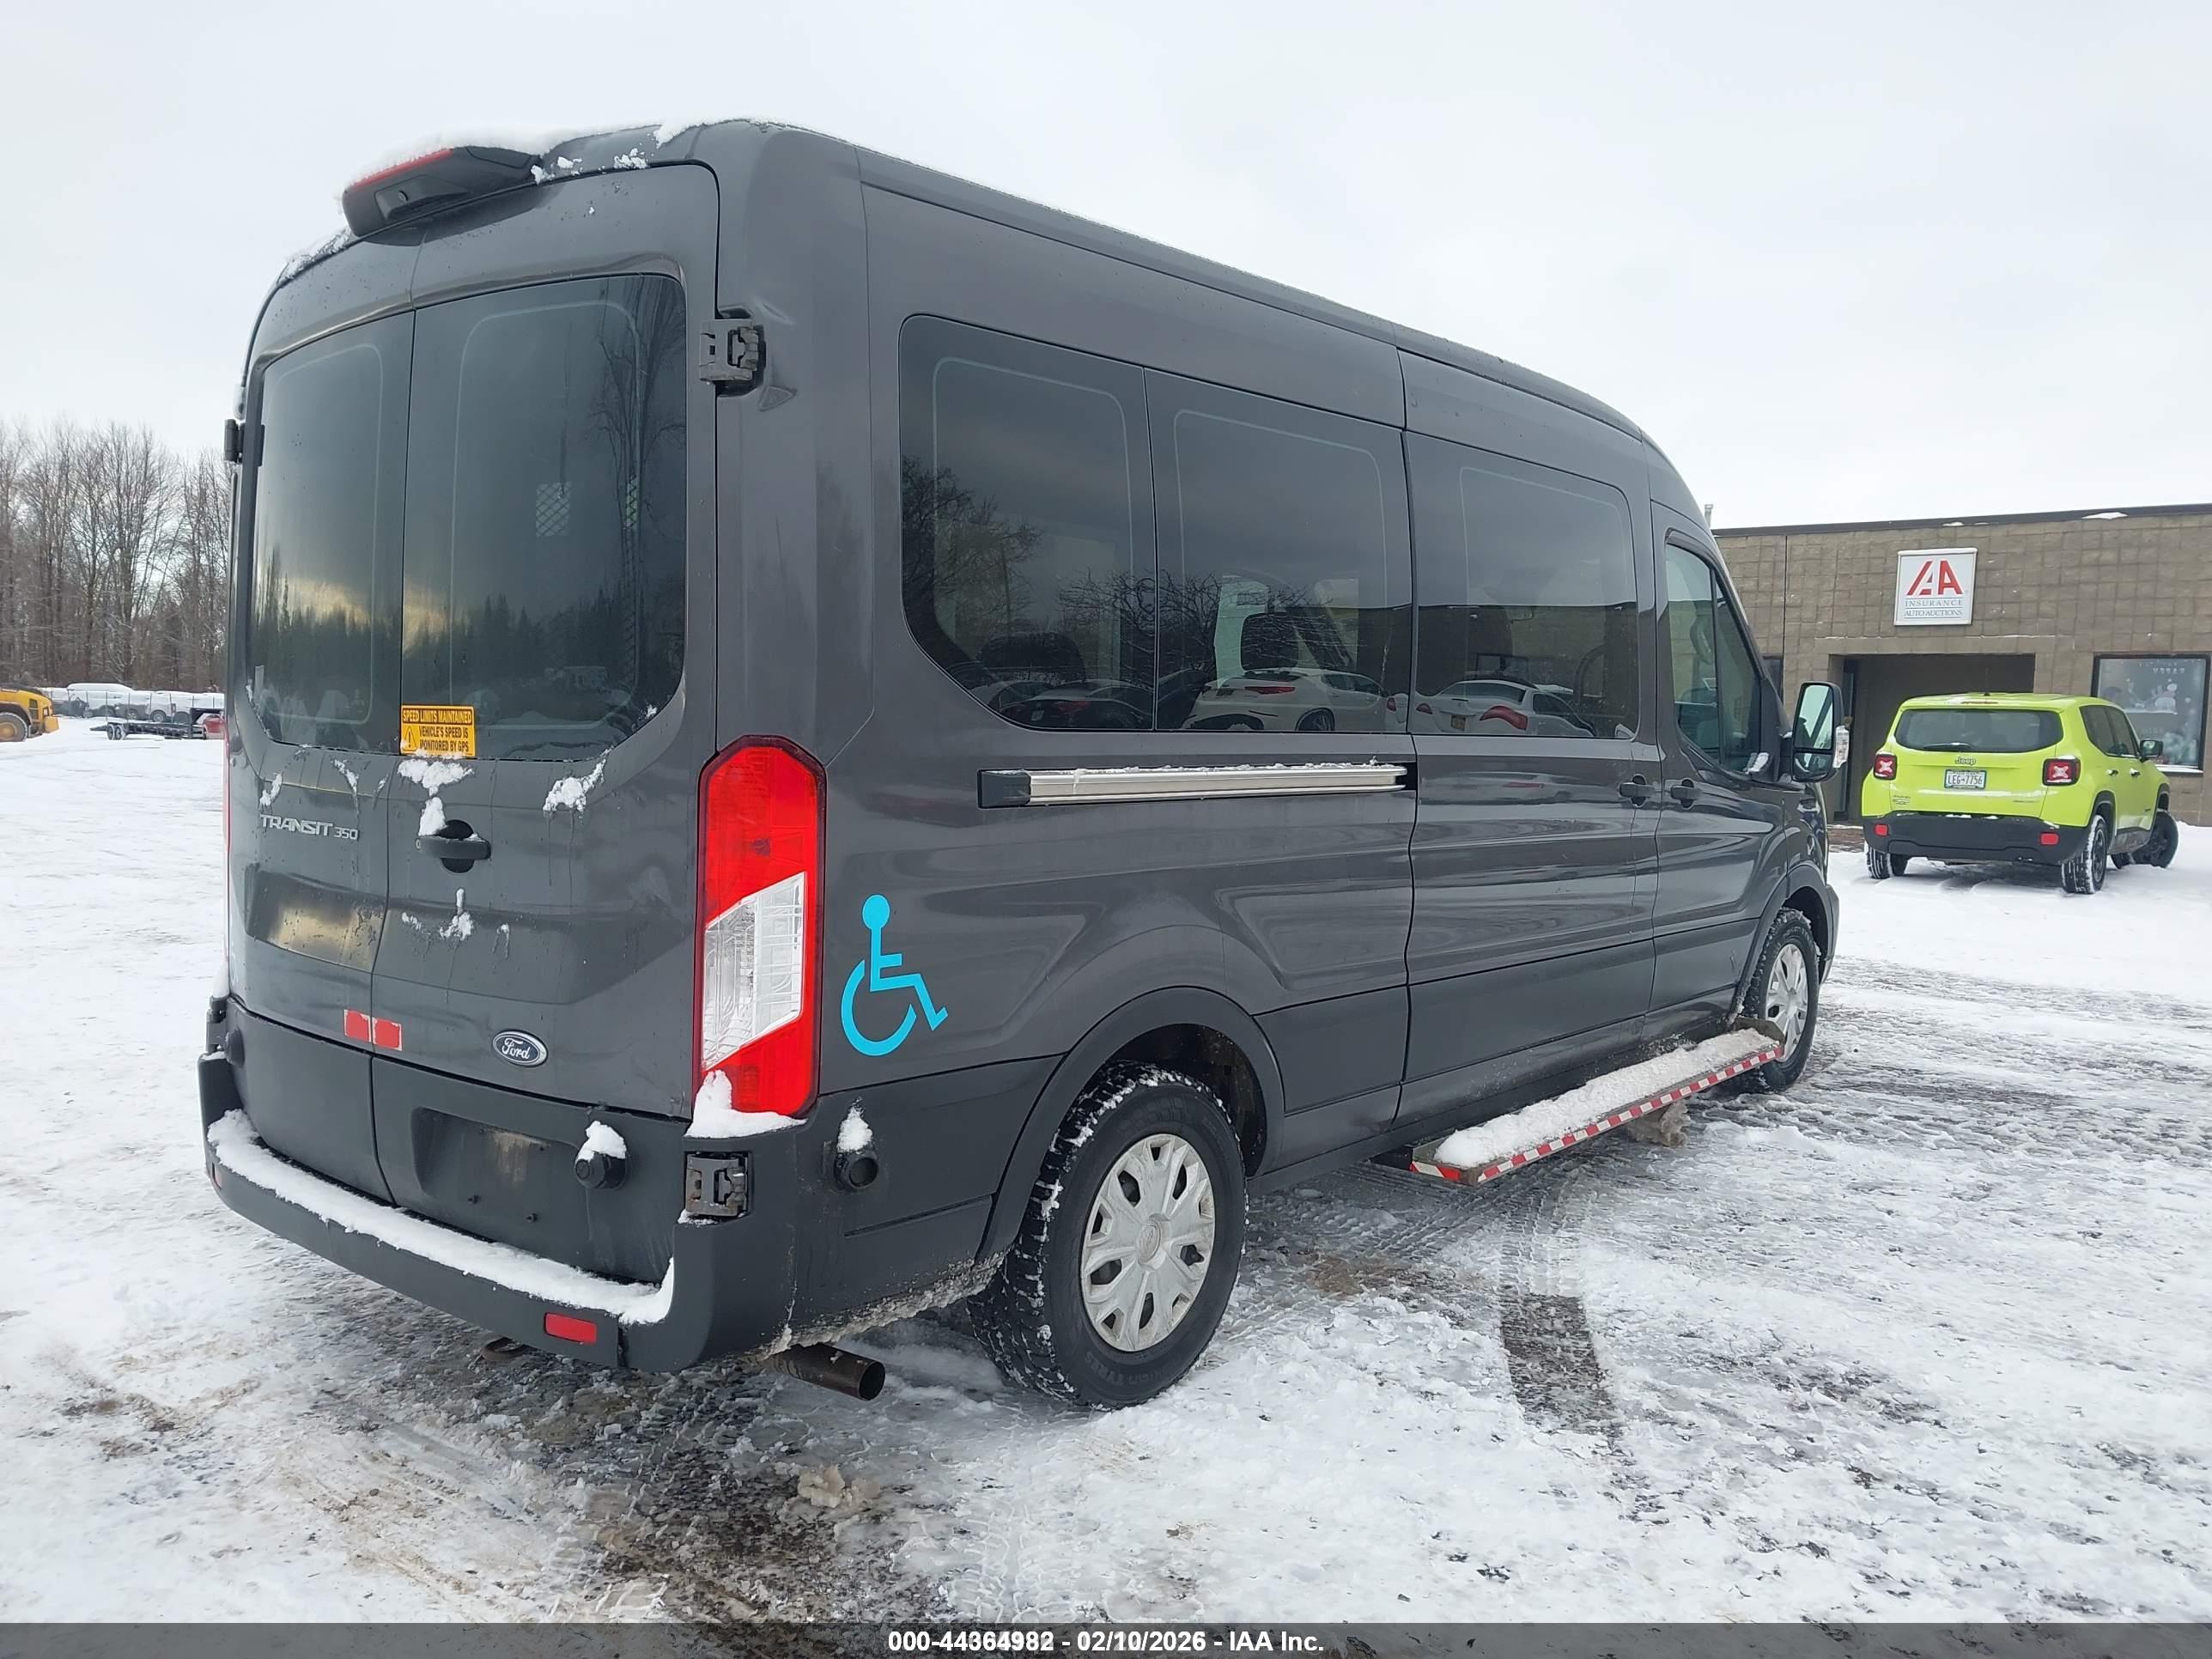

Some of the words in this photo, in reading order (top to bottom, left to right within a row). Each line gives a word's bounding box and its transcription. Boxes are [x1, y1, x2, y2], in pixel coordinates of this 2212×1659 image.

[1924, 609, 1963, 617] AUCTIONS
[403, 709, 420, 722] SPEED
[420, 709, 438, 723] LIMITS
[438, 710, 472, 724] MAINTAINED
[419, 726, 444, 738] VEHICLE'S
[445, 726, 462, 739] SPEED
[463, 727, 469, 739] IS
[420, 739, 449, 752] MONITORED
[450, 740, 457, 752] BY
[458, 740, 470, 753] GPS
[1954, 756, 1977, 767] Jeep
[260, 813, 333, 837] TRANSIT
[333, 826, 359, 841] 350
[501, 1037, 531, 1060] Ford
